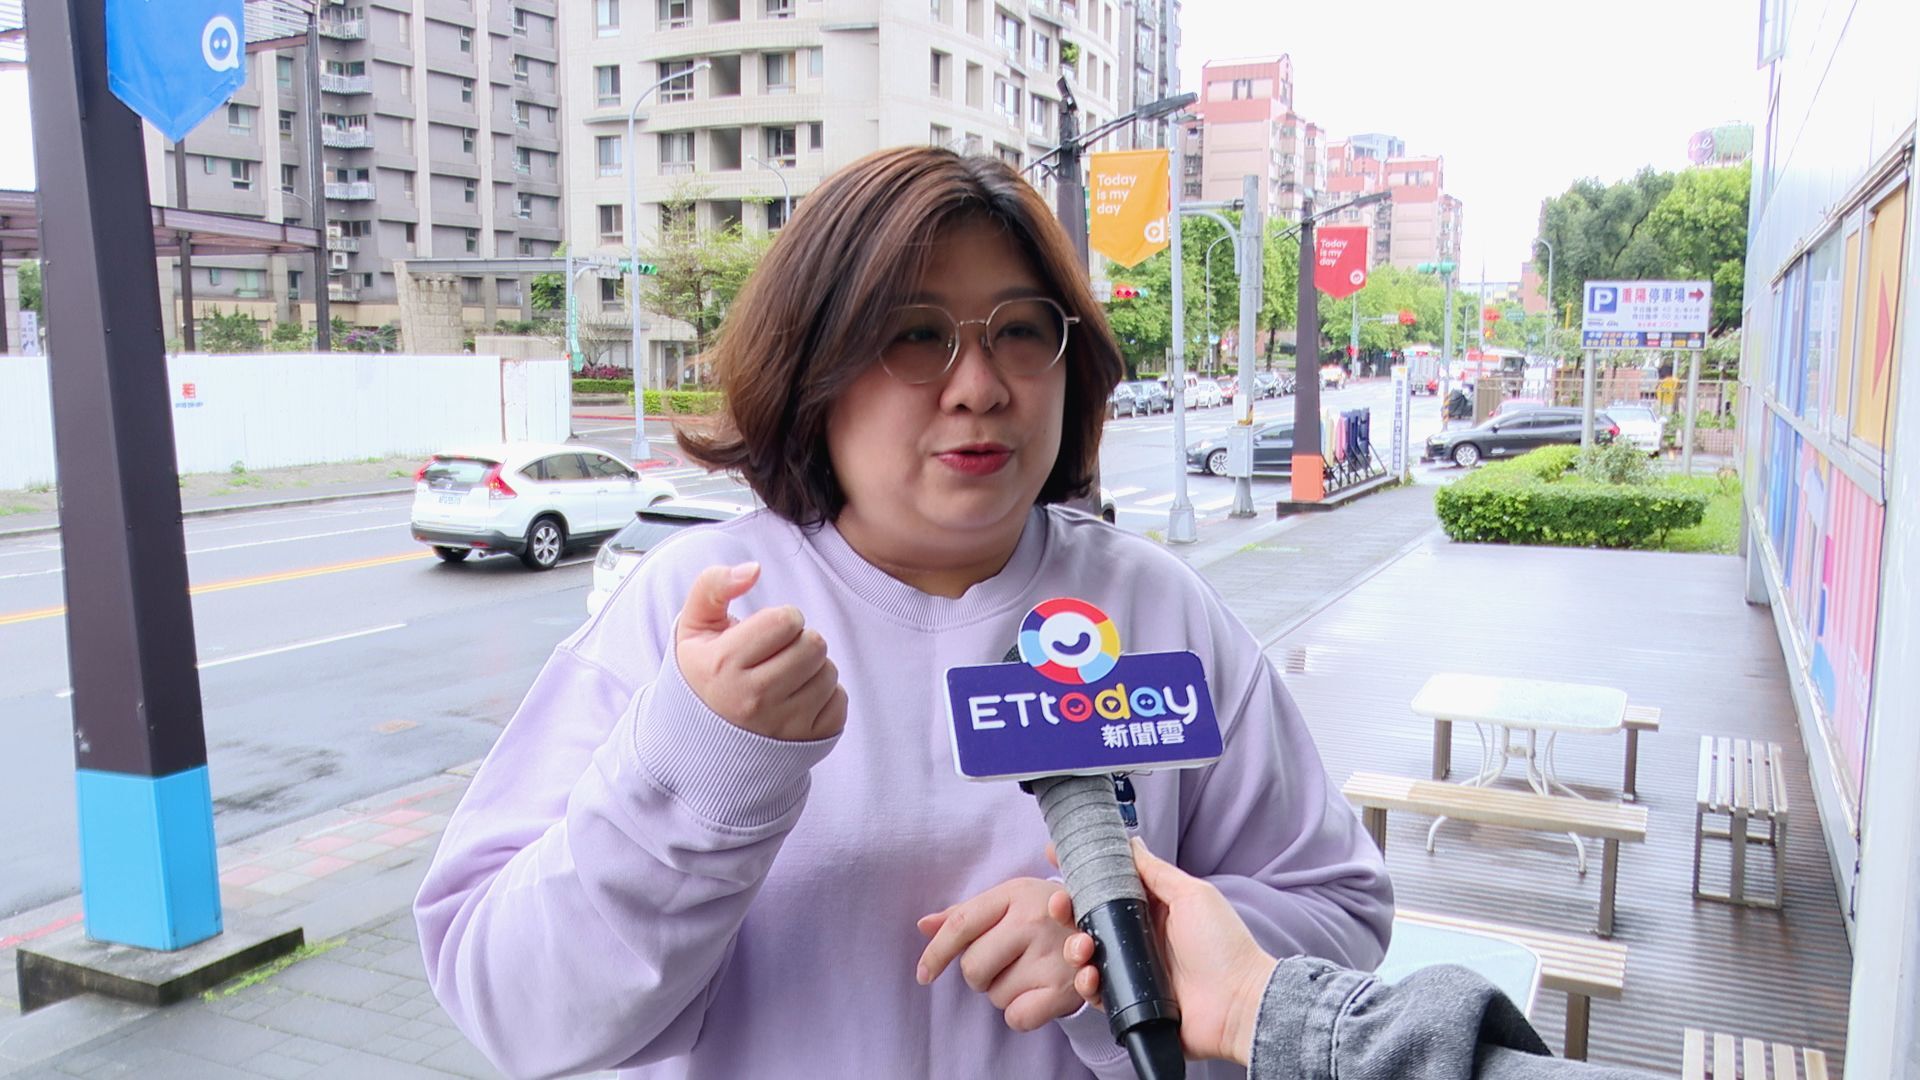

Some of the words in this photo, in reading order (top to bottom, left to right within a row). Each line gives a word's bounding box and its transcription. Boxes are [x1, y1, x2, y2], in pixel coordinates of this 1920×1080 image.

[1097, 173, 1137, 188] Today
[1097, 188, 1107, 201] is
[1109, 190, 1130, 203] my
[1096, 204, 1121, 217] day
[1320, 239, 1348, 249] Today
[1328, 249, 1343, 258] my
[1319, 258, 1336, 267] day
[1594, 289, 1613, 312] P
[1622, 287, 1685, 304] 重陽停車場
[968, 683, 1198, 730] ETtoday
[1101, 719, 1185, 749] 新聞雲
